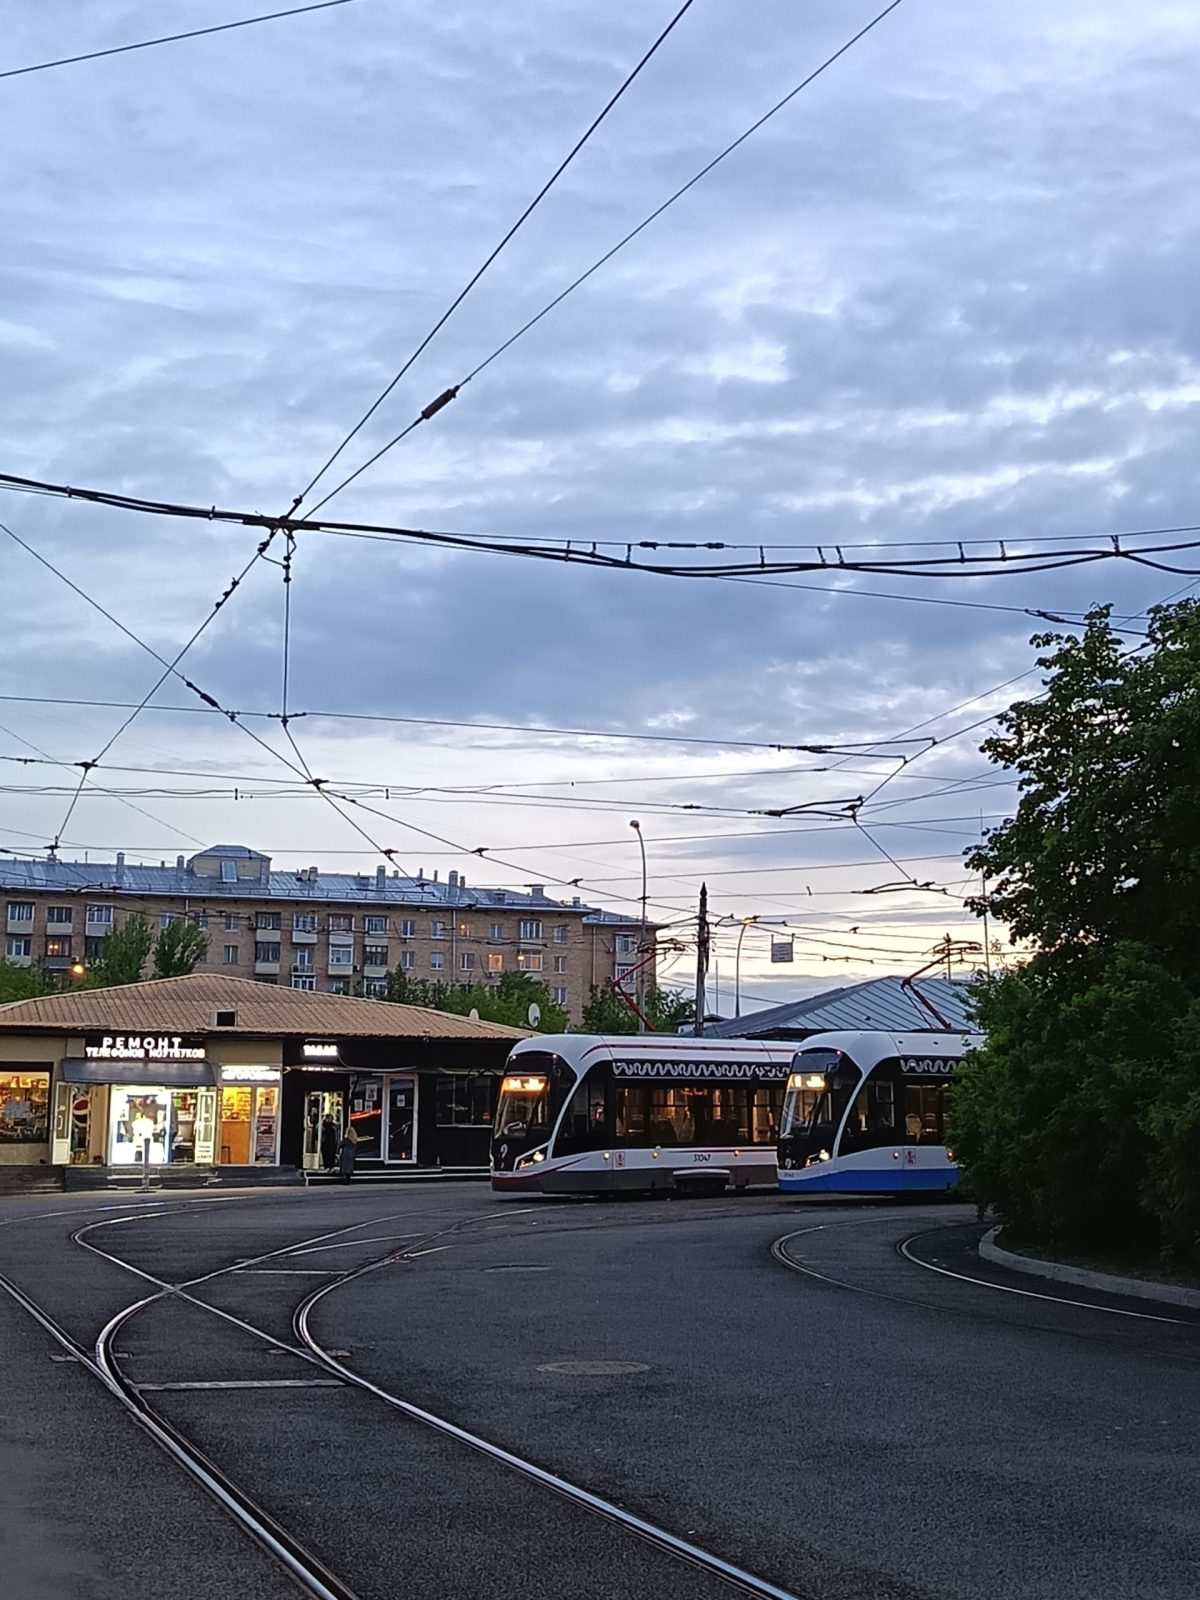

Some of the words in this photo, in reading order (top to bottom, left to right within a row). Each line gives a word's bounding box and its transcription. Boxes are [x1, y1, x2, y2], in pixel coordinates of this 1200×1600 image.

[102, 1037, 182, 1049] РЕМОНТ
[86, 1047, 145, 1058] ТЕЛЕФОНОВ
[149, 1048, 205, 1058] НОУТБУКОВ
